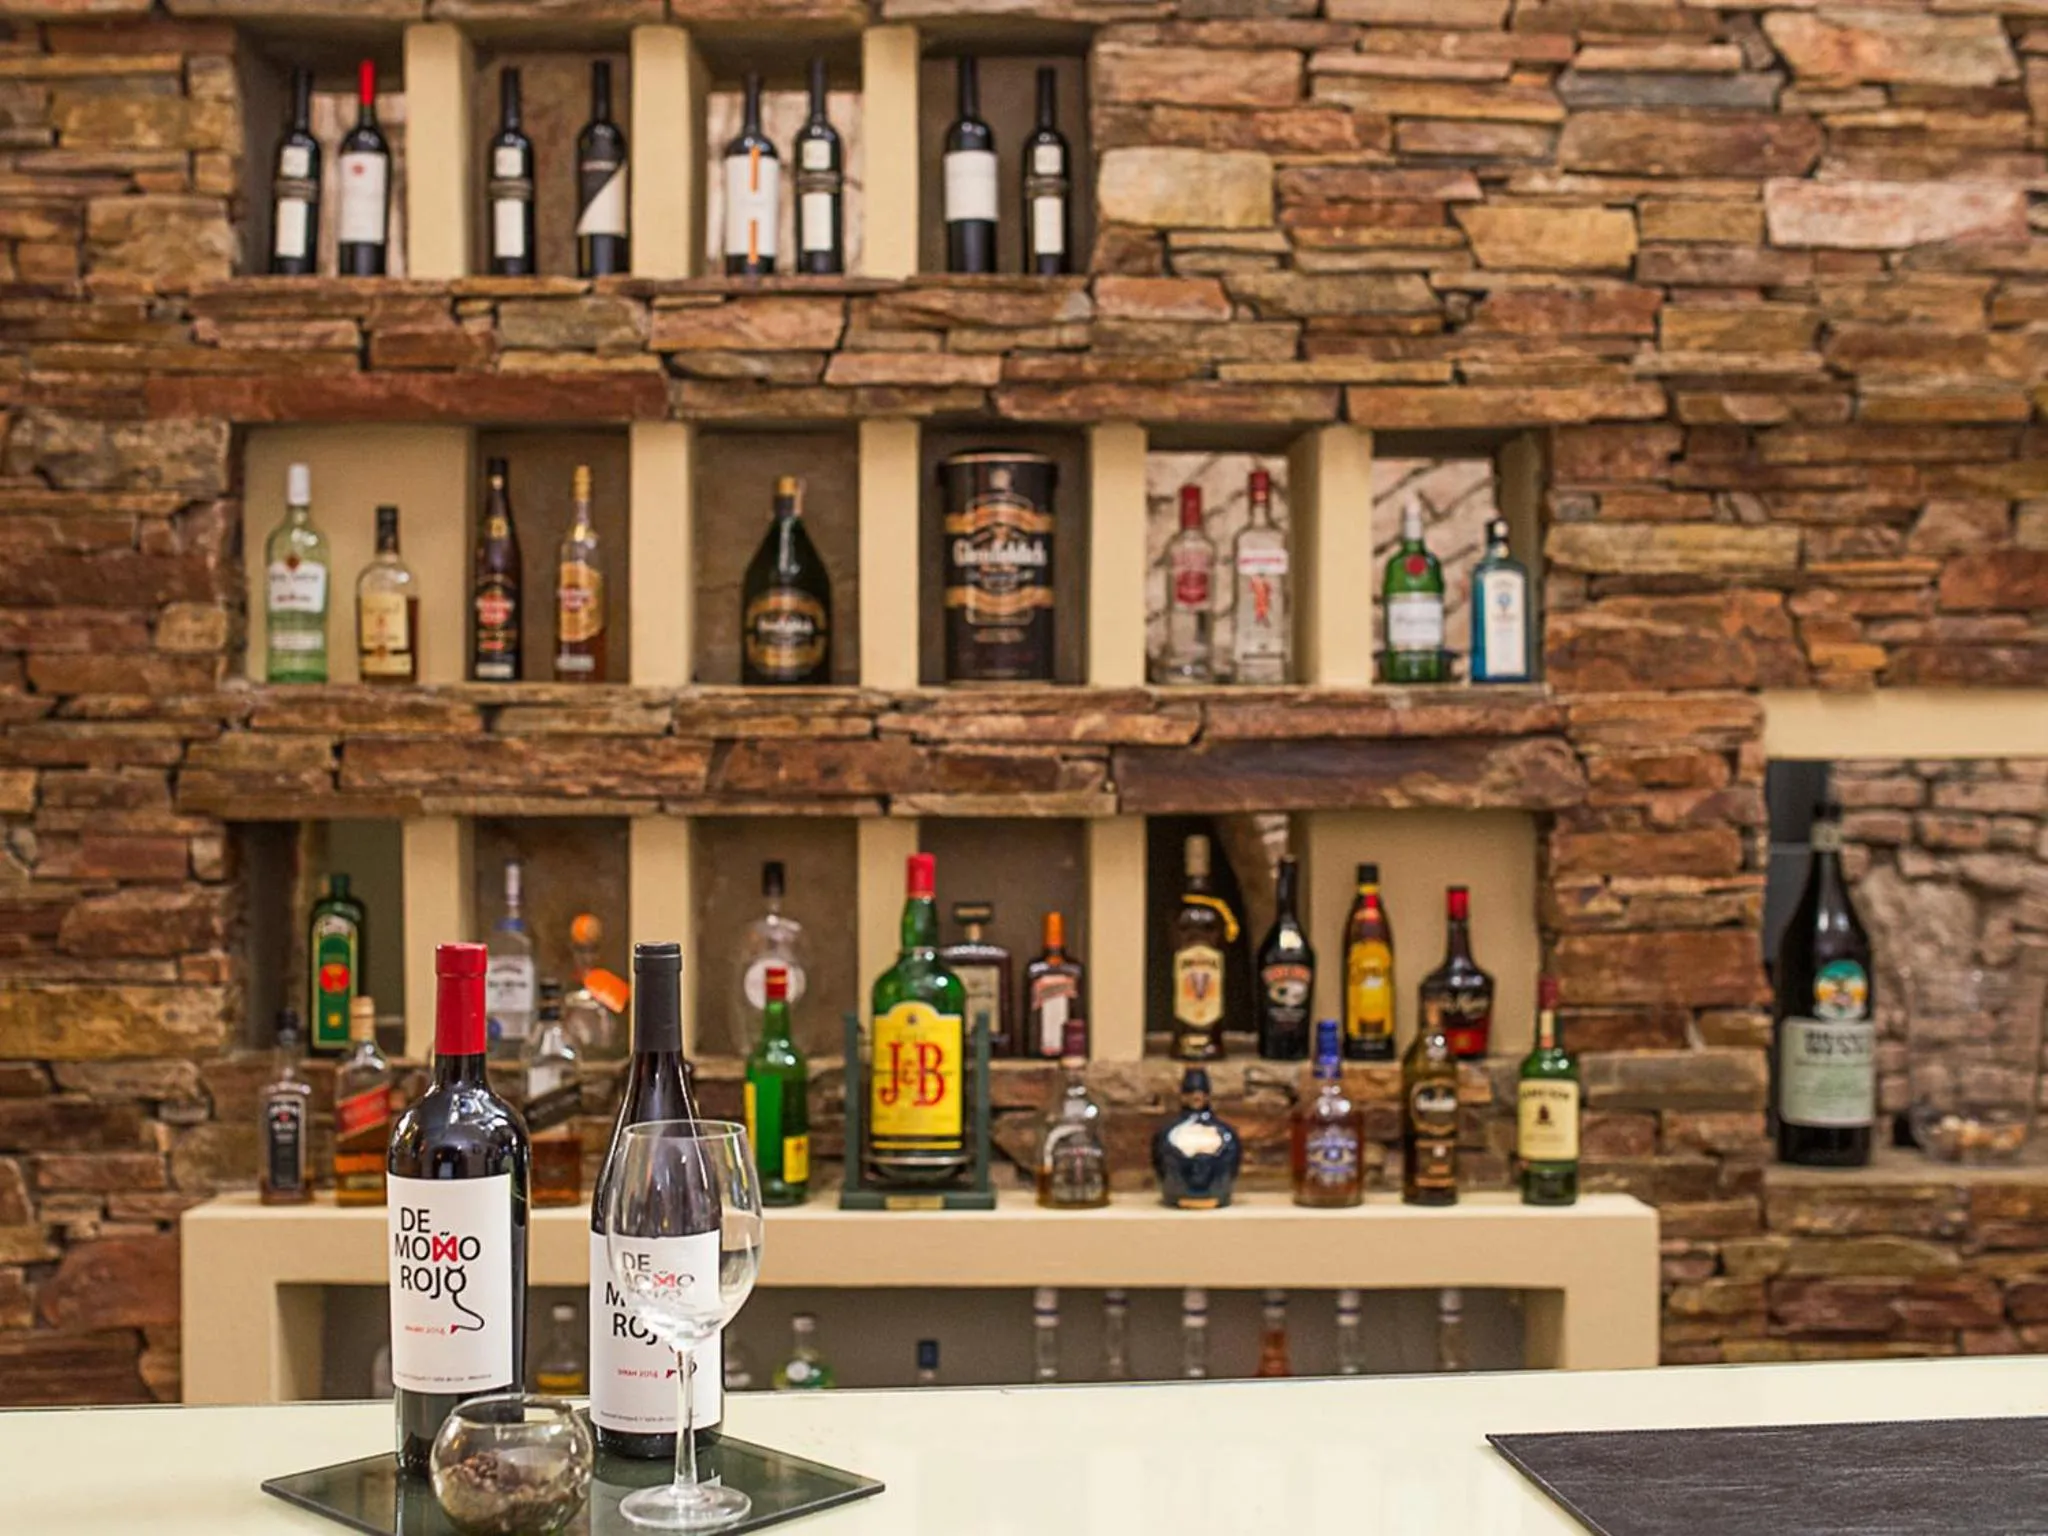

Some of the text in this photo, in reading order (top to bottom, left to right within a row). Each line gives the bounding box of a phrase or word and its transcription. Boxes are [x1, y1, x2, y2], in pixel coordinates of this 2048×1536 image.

[878, 1040, 945, 1107] J&B
[400, 1206, 431, 1234] DE
[622, 1251, 652, 1272] DE
[400, 1265, 467, 1300] ROJO
